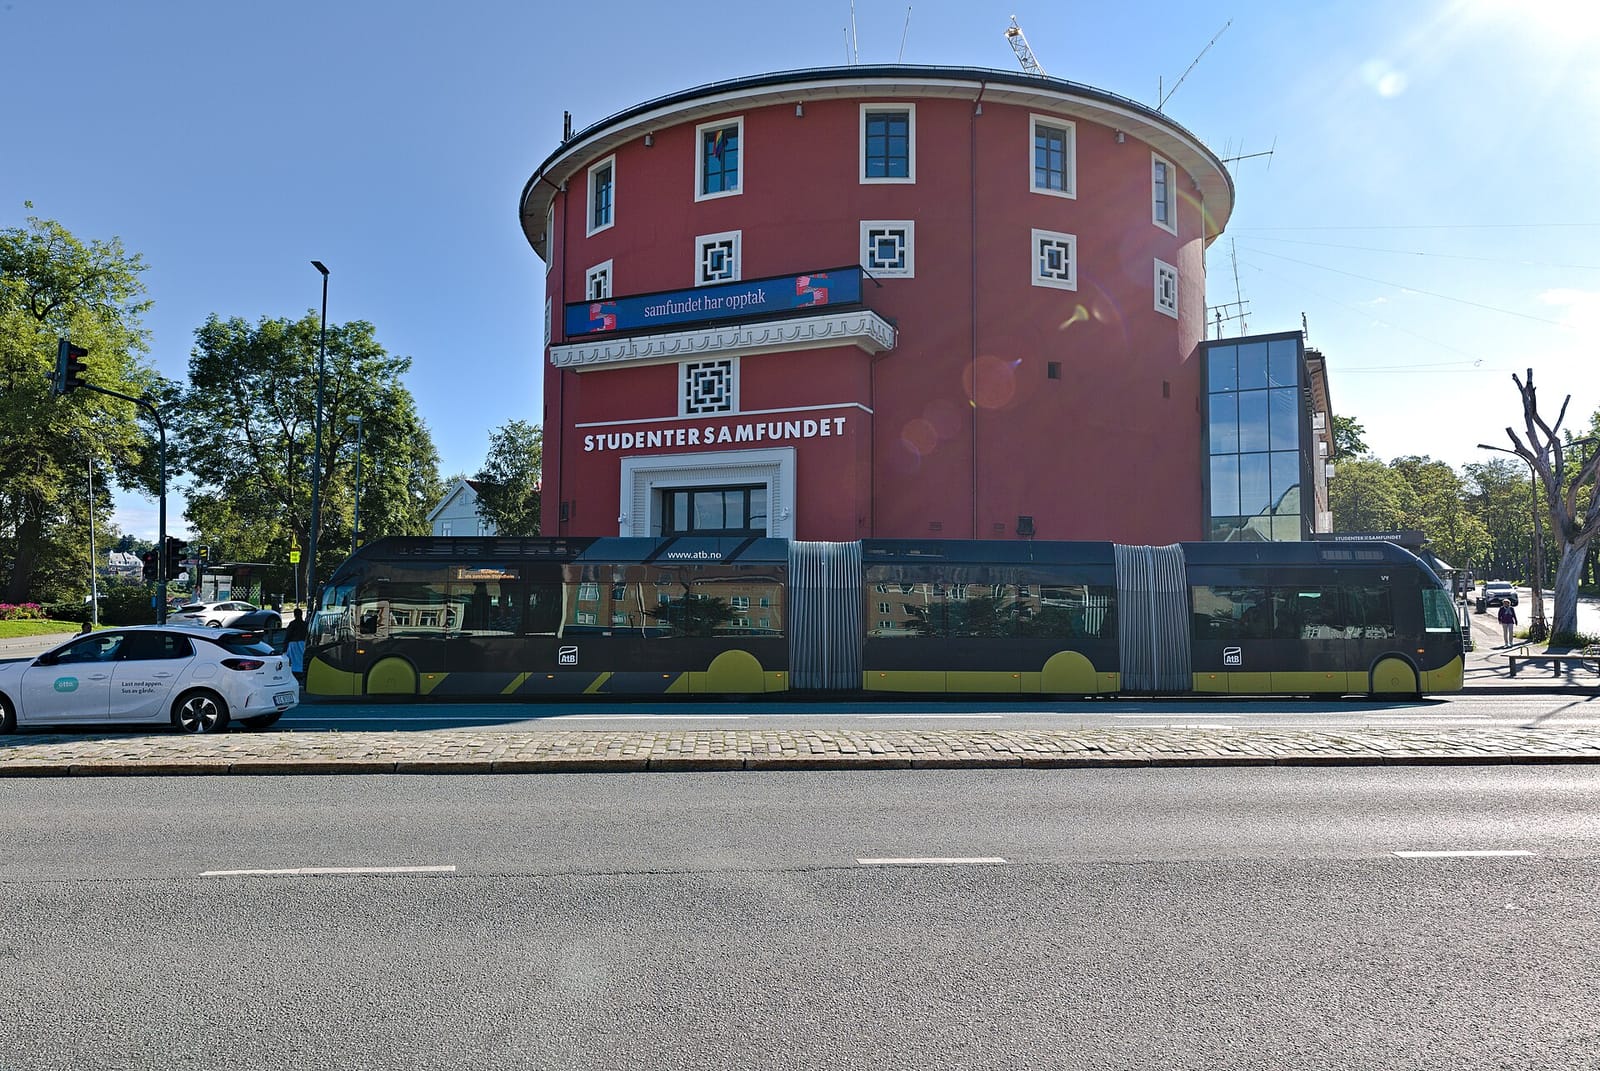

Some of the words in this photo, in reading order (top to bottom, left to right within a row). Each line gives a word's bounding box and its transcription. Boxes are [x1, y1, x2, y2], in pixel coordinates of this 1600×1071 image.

[644, 297, 701, 318] samfundet
[703, 295, 722, 310] har
[725, 288, 766, 309] opptak
[584, 417, 846, 452] STUDENTERSAMFUNDET
[667, 550, 722, 559] www.atb.no
[561, 654, 576, 663] AtB
[1226, 655, 1240, 663] AtB
